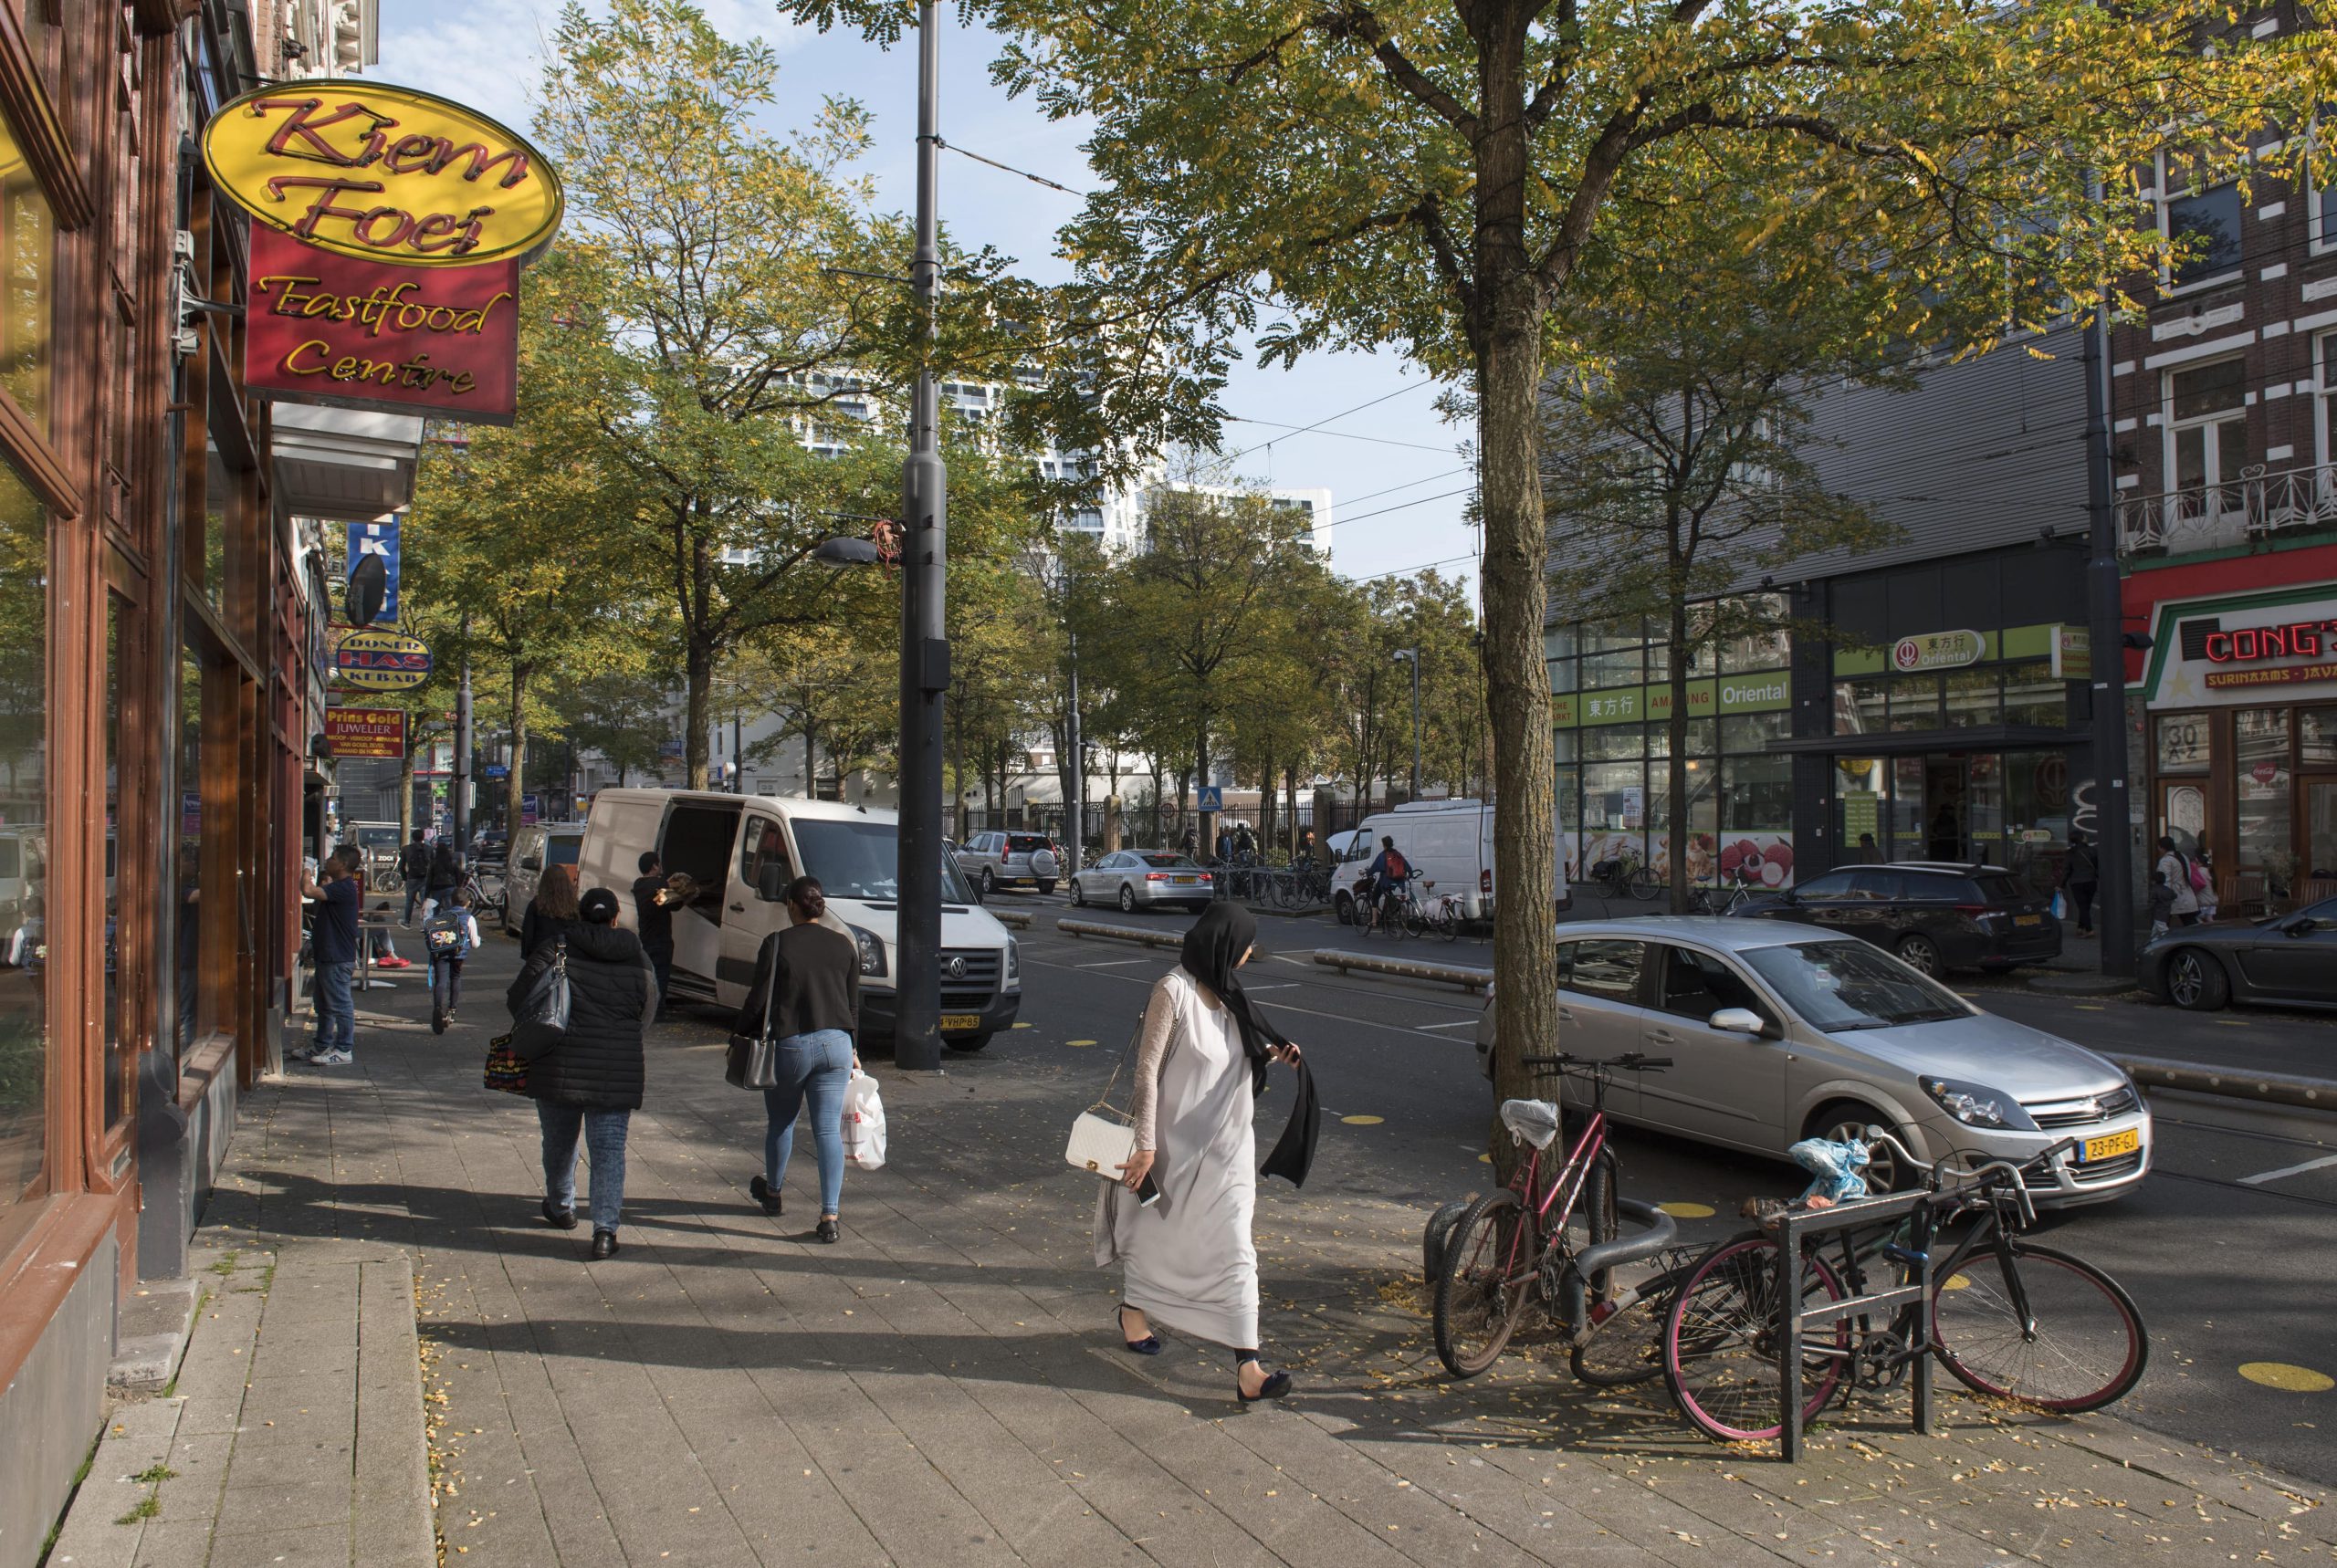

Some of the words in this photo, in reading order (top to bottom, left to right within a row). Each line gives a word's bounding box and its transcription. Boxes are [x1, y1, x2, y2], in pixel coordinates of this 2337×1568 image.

[250, 98, 529, 189] Kiem
[267, 175, 496, 255] Foei
[286, 340, 476, 394] Centre
[350, 639, 420, 651] DONER
[339, 651, 429, 670] HAS
[1922, 649, 1971, 665] Oriental
[350, 672, 418, 683] KEBAB
[2207, 668, 2290, 686] SURINAAMS
[1722, 680, 1787, 706] Oriental
[1588, 695, 1634, 718] 東方行
[328, 711, 362, 723] Prins
[366, 714, 400, 725] Gold
[337, 723, 392, 735] JUWELIER
[2168, 724, 2197, 746] 30
